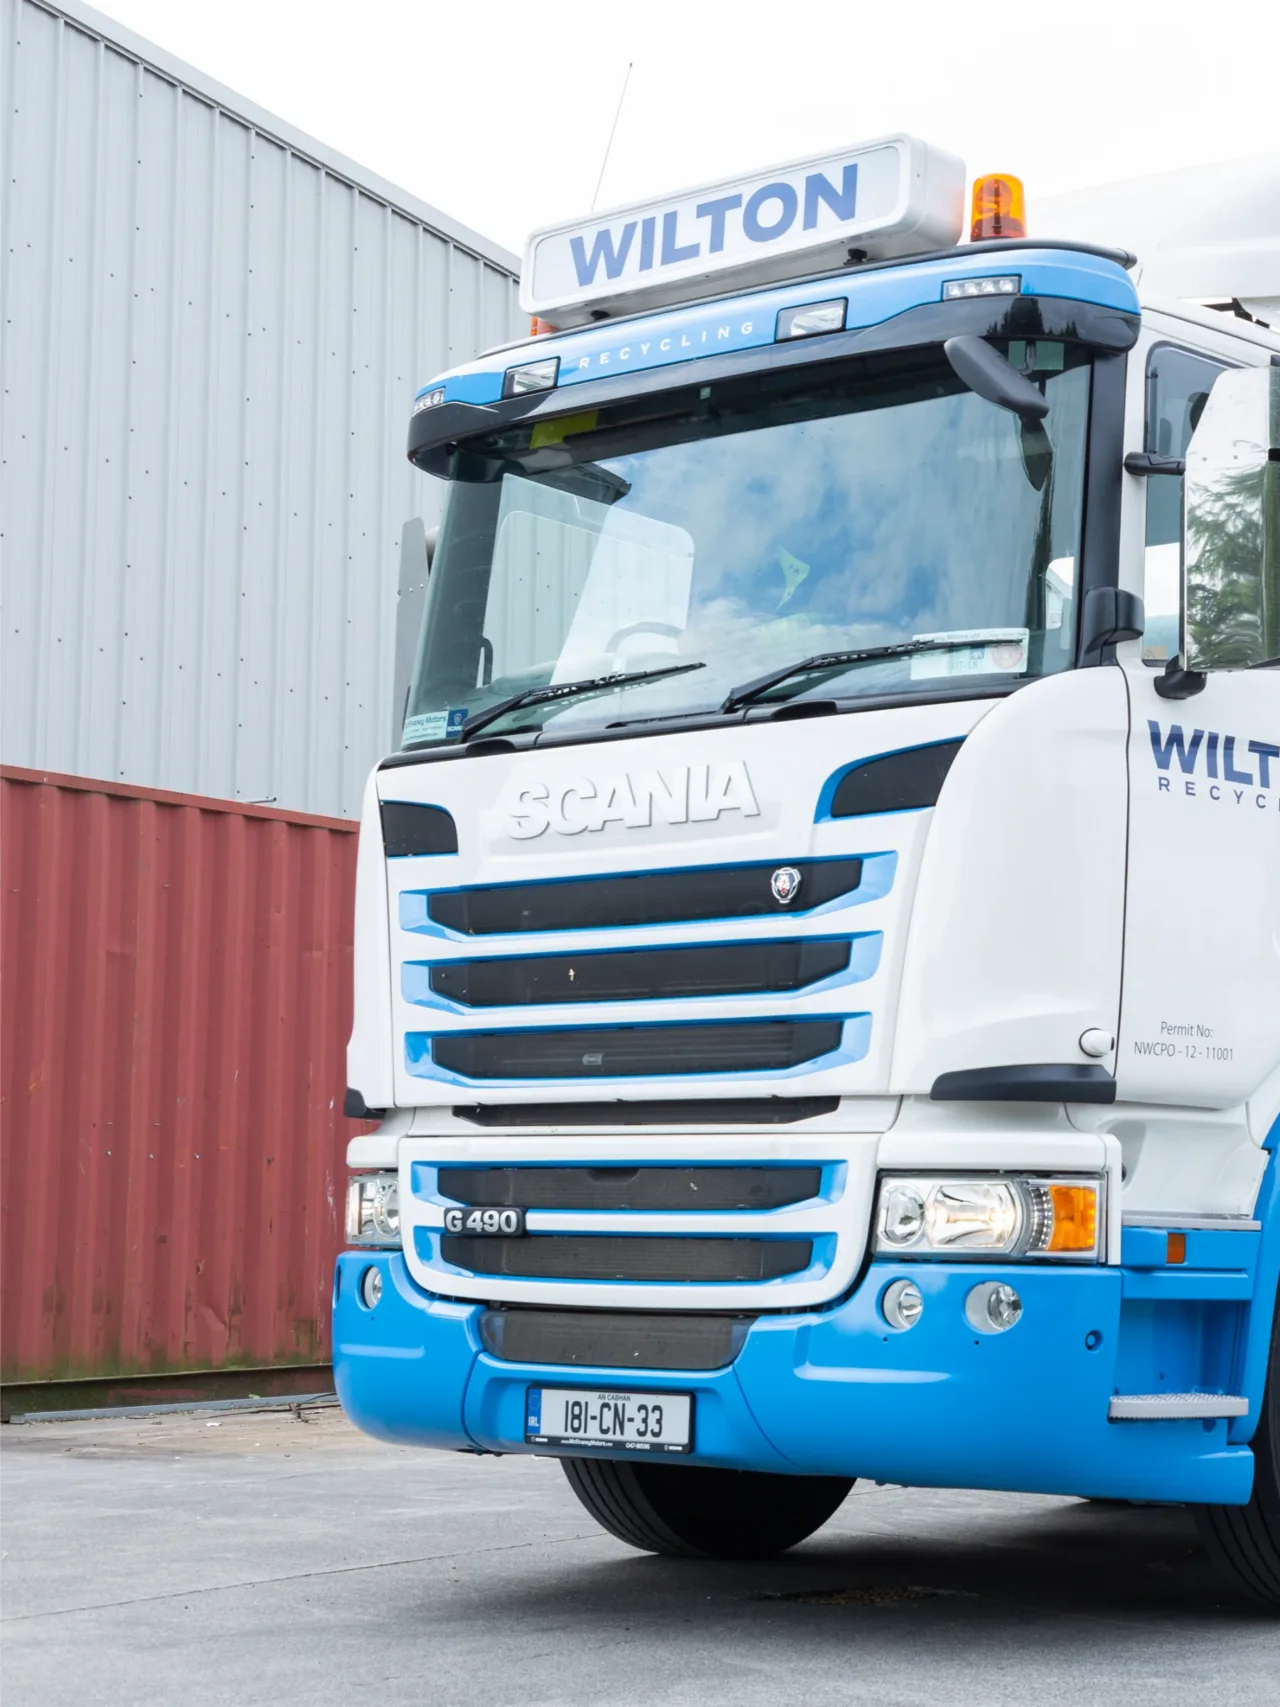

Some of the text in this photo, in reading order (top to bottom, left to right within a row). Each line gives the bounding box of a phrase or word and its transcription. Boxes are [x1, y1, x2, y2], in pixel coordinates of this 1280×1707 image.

[569, 163, 858, 287] WILTON
[578, 321, 754, 369] RECYCLING
[508, 760, 761, 840] SCANIA
[1161, 1021, 1213, 1038] Permit No:
[1134, 1041, 1176, 1057] NWCPO
[1185, 1045, 1197, 1059] 12
[1206, 1047, 1233, 1060] 11001
[446, 1210, 517, 1233] G 490
[528, 1416, 540, 1427] IRL
[564, 1400, 663, 1438] 181-CN-33
